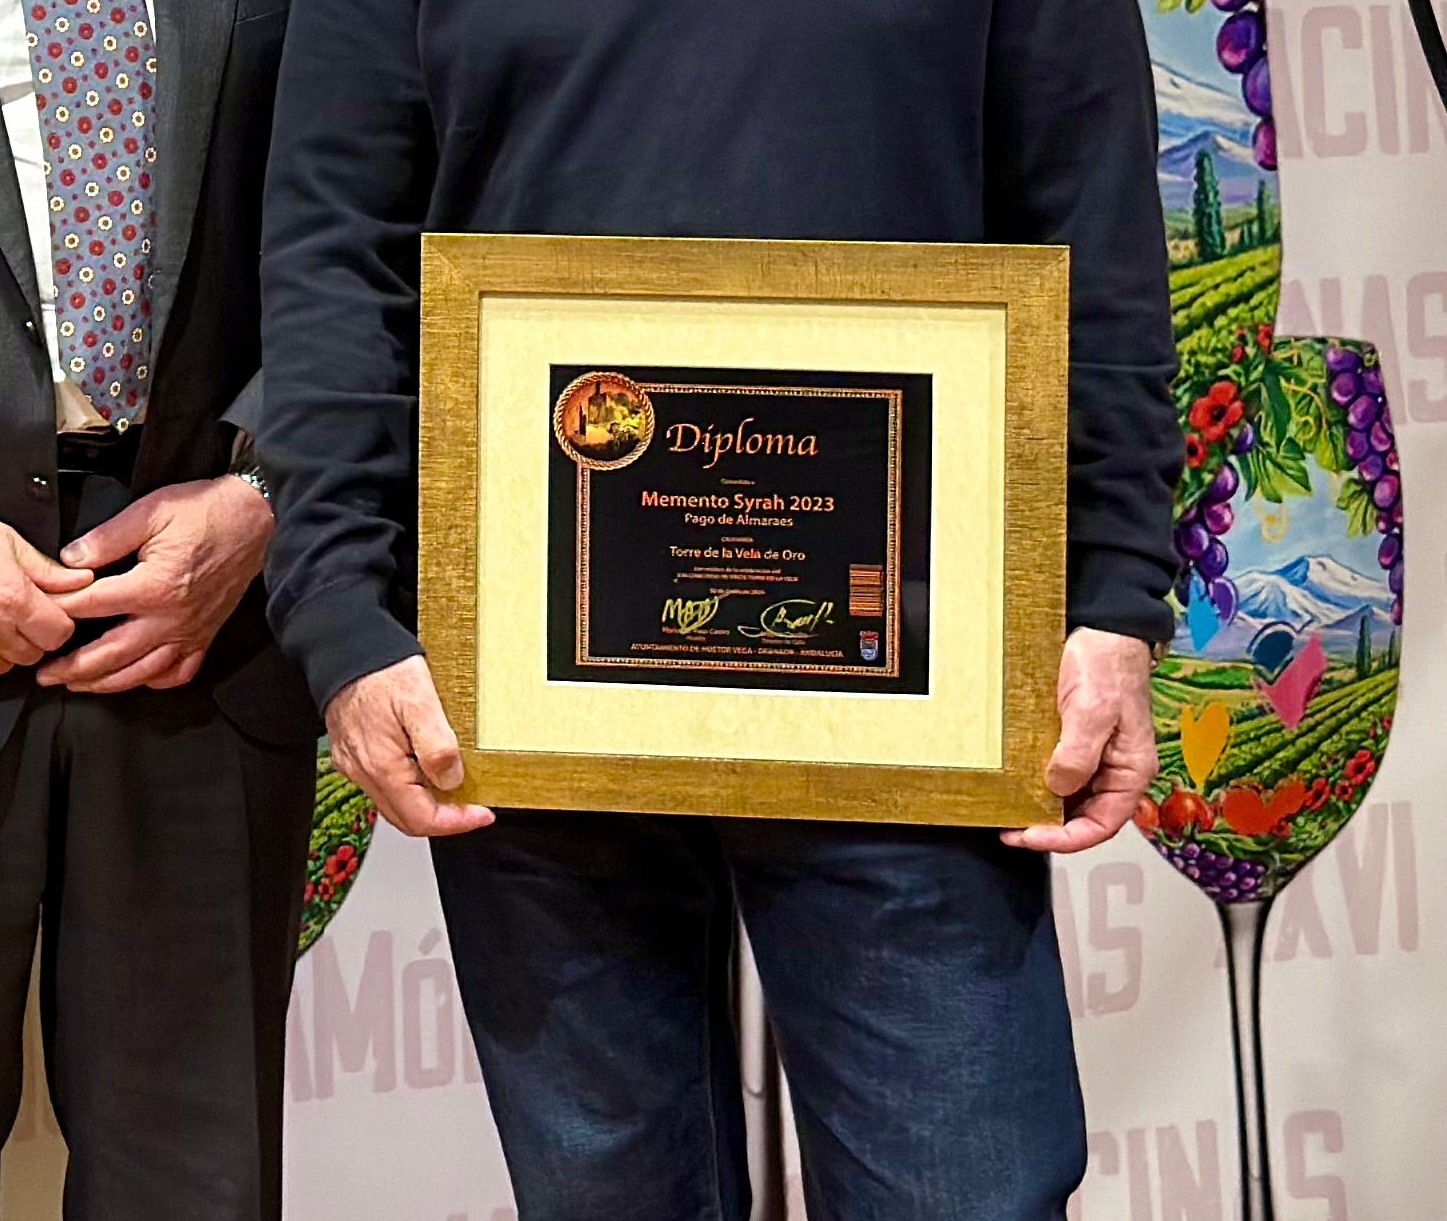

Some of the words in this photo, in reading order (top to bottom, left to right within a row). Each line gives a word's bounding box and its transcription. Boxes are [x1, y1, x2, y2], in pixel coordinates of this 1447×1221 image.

[665, 417, 819, 469] Diploma
[641, 491, 729, 508] Memento
[733, 493, 785, 513] Syrah
[789, 495, 835, 512] 2023
[684, 513, 715, 527] Pago
[717, 513, 733, 525] de
[669, 545, 701, 559] Torre
[703, 546, 719, 559] de
[721, 547, 733, 560] la
[763, 549, 780, 561] de
[782, 549, 806, 562] Oro
